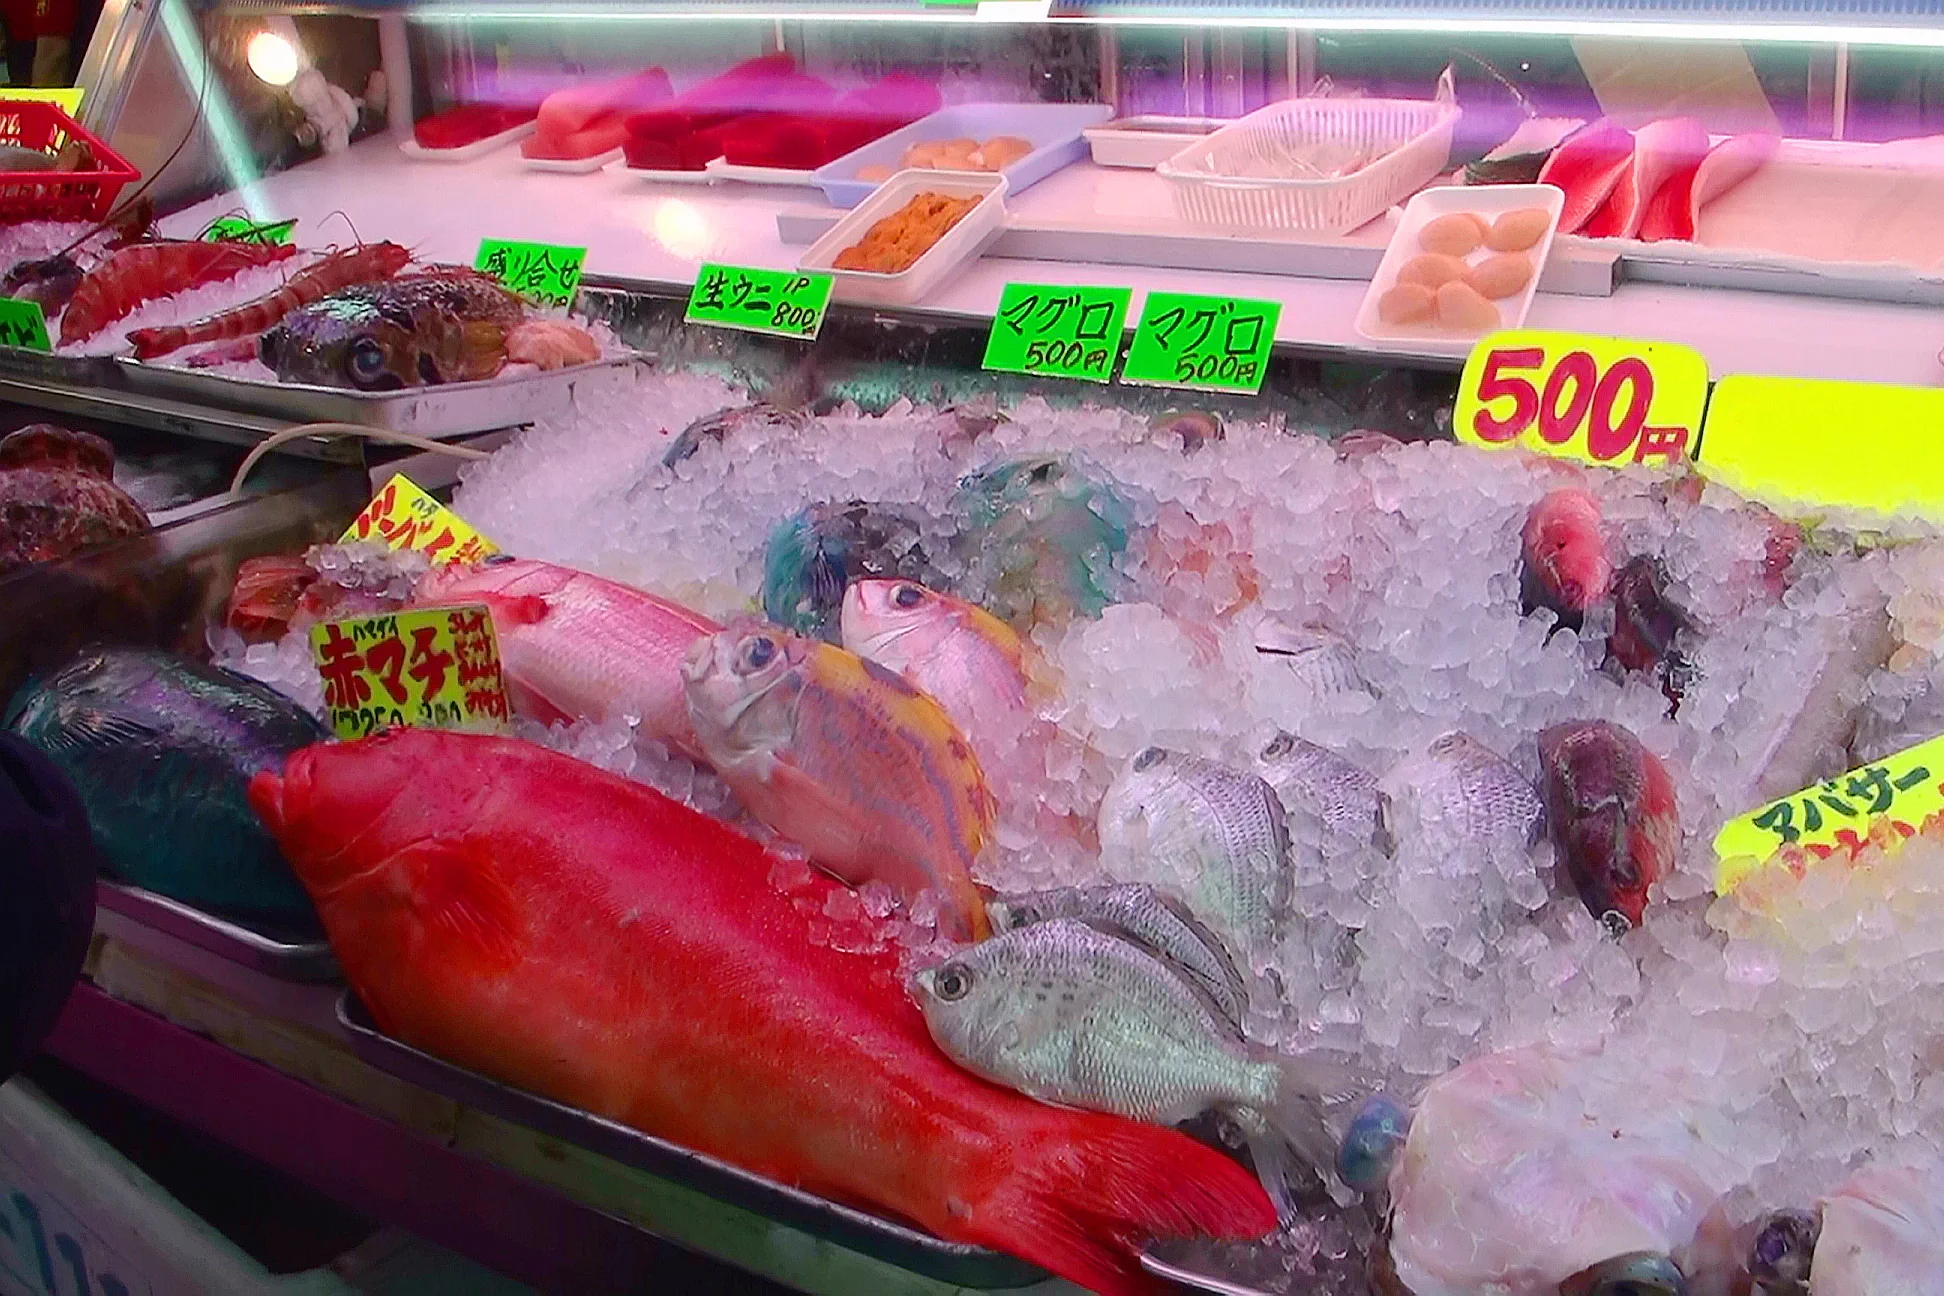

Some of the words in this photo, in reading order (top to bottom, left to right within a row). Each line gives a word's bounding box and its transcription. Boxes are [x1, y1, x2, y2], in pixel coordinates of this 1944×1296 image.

[694, 269, 772, 311] 生ウニ
[1001, 293, 1115, 341] マグロ
[1149, 302, 1264, 355] マグロ
[1024, 340, 1109, 372] 500円
[1174, 352, 1258, 384] 500円
[1472, 347, 1689, 463] 500円
[318, 623, 455, 711] 赤マチ
